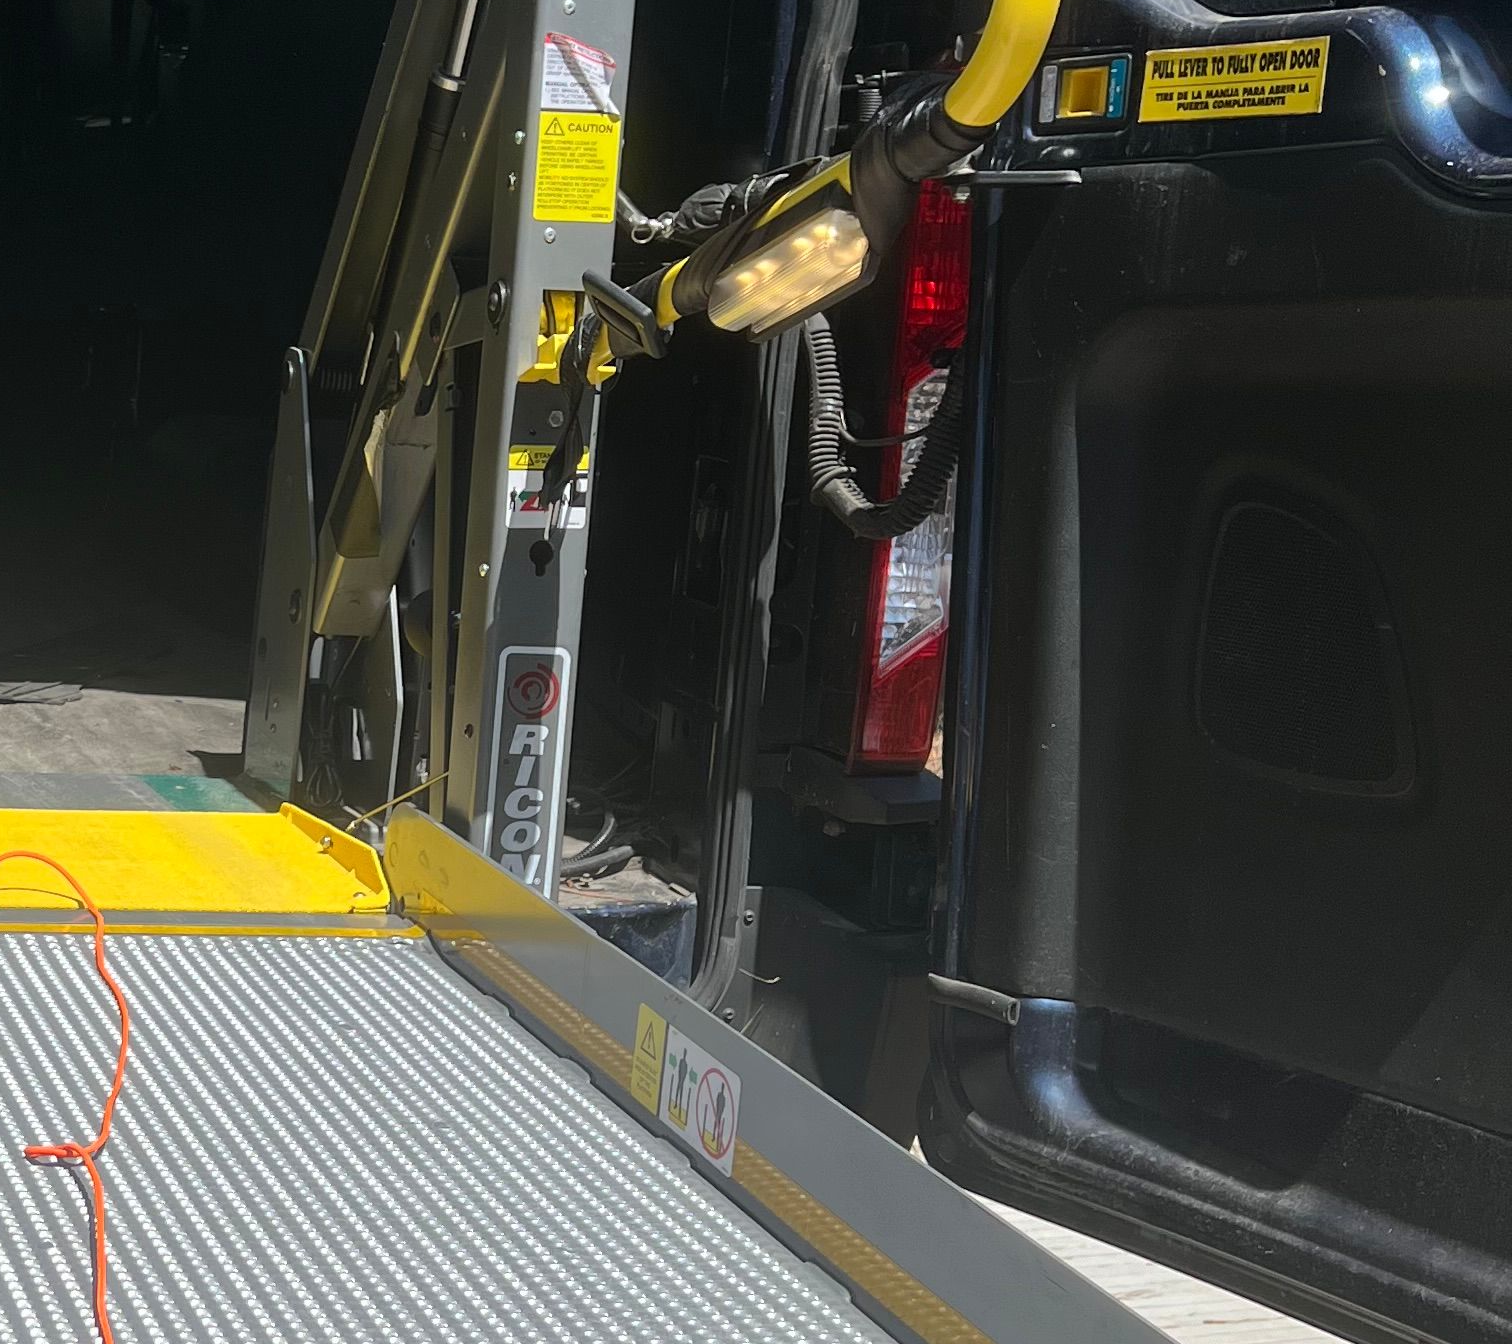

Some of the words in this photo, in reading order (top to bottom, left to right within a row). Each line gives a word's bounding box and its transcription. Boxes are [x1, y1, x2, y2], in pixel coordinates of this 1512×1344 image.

[1151, 60, 1175, 80] PULL
[1178, 57, 1209, 77] LEVER
[1211, 57, 1224, 76] TO
[1227, 53, 1257, 75] FULLY
[1259, 51, 1287, 72] OPEN
[1290, 48, 1320, 69] DOOR
[1156, 92, 1174, 102] TIRE
[1177, 91, 1188, 101] DE
[1191, 90, 1202, 100] LA
[1242, 86, 1265, 96] PARA
[1268, 84, 1296, 95] ABRIR
[1298, 82, 1310, 93] LA
[1176, 99, 1209, 111] PUERTA
[1213, 96, 1286, 110] COMPLETAMENTE
[568, 123, 613, 133] CAUTION
[501, 724, 549, 885] RICON
